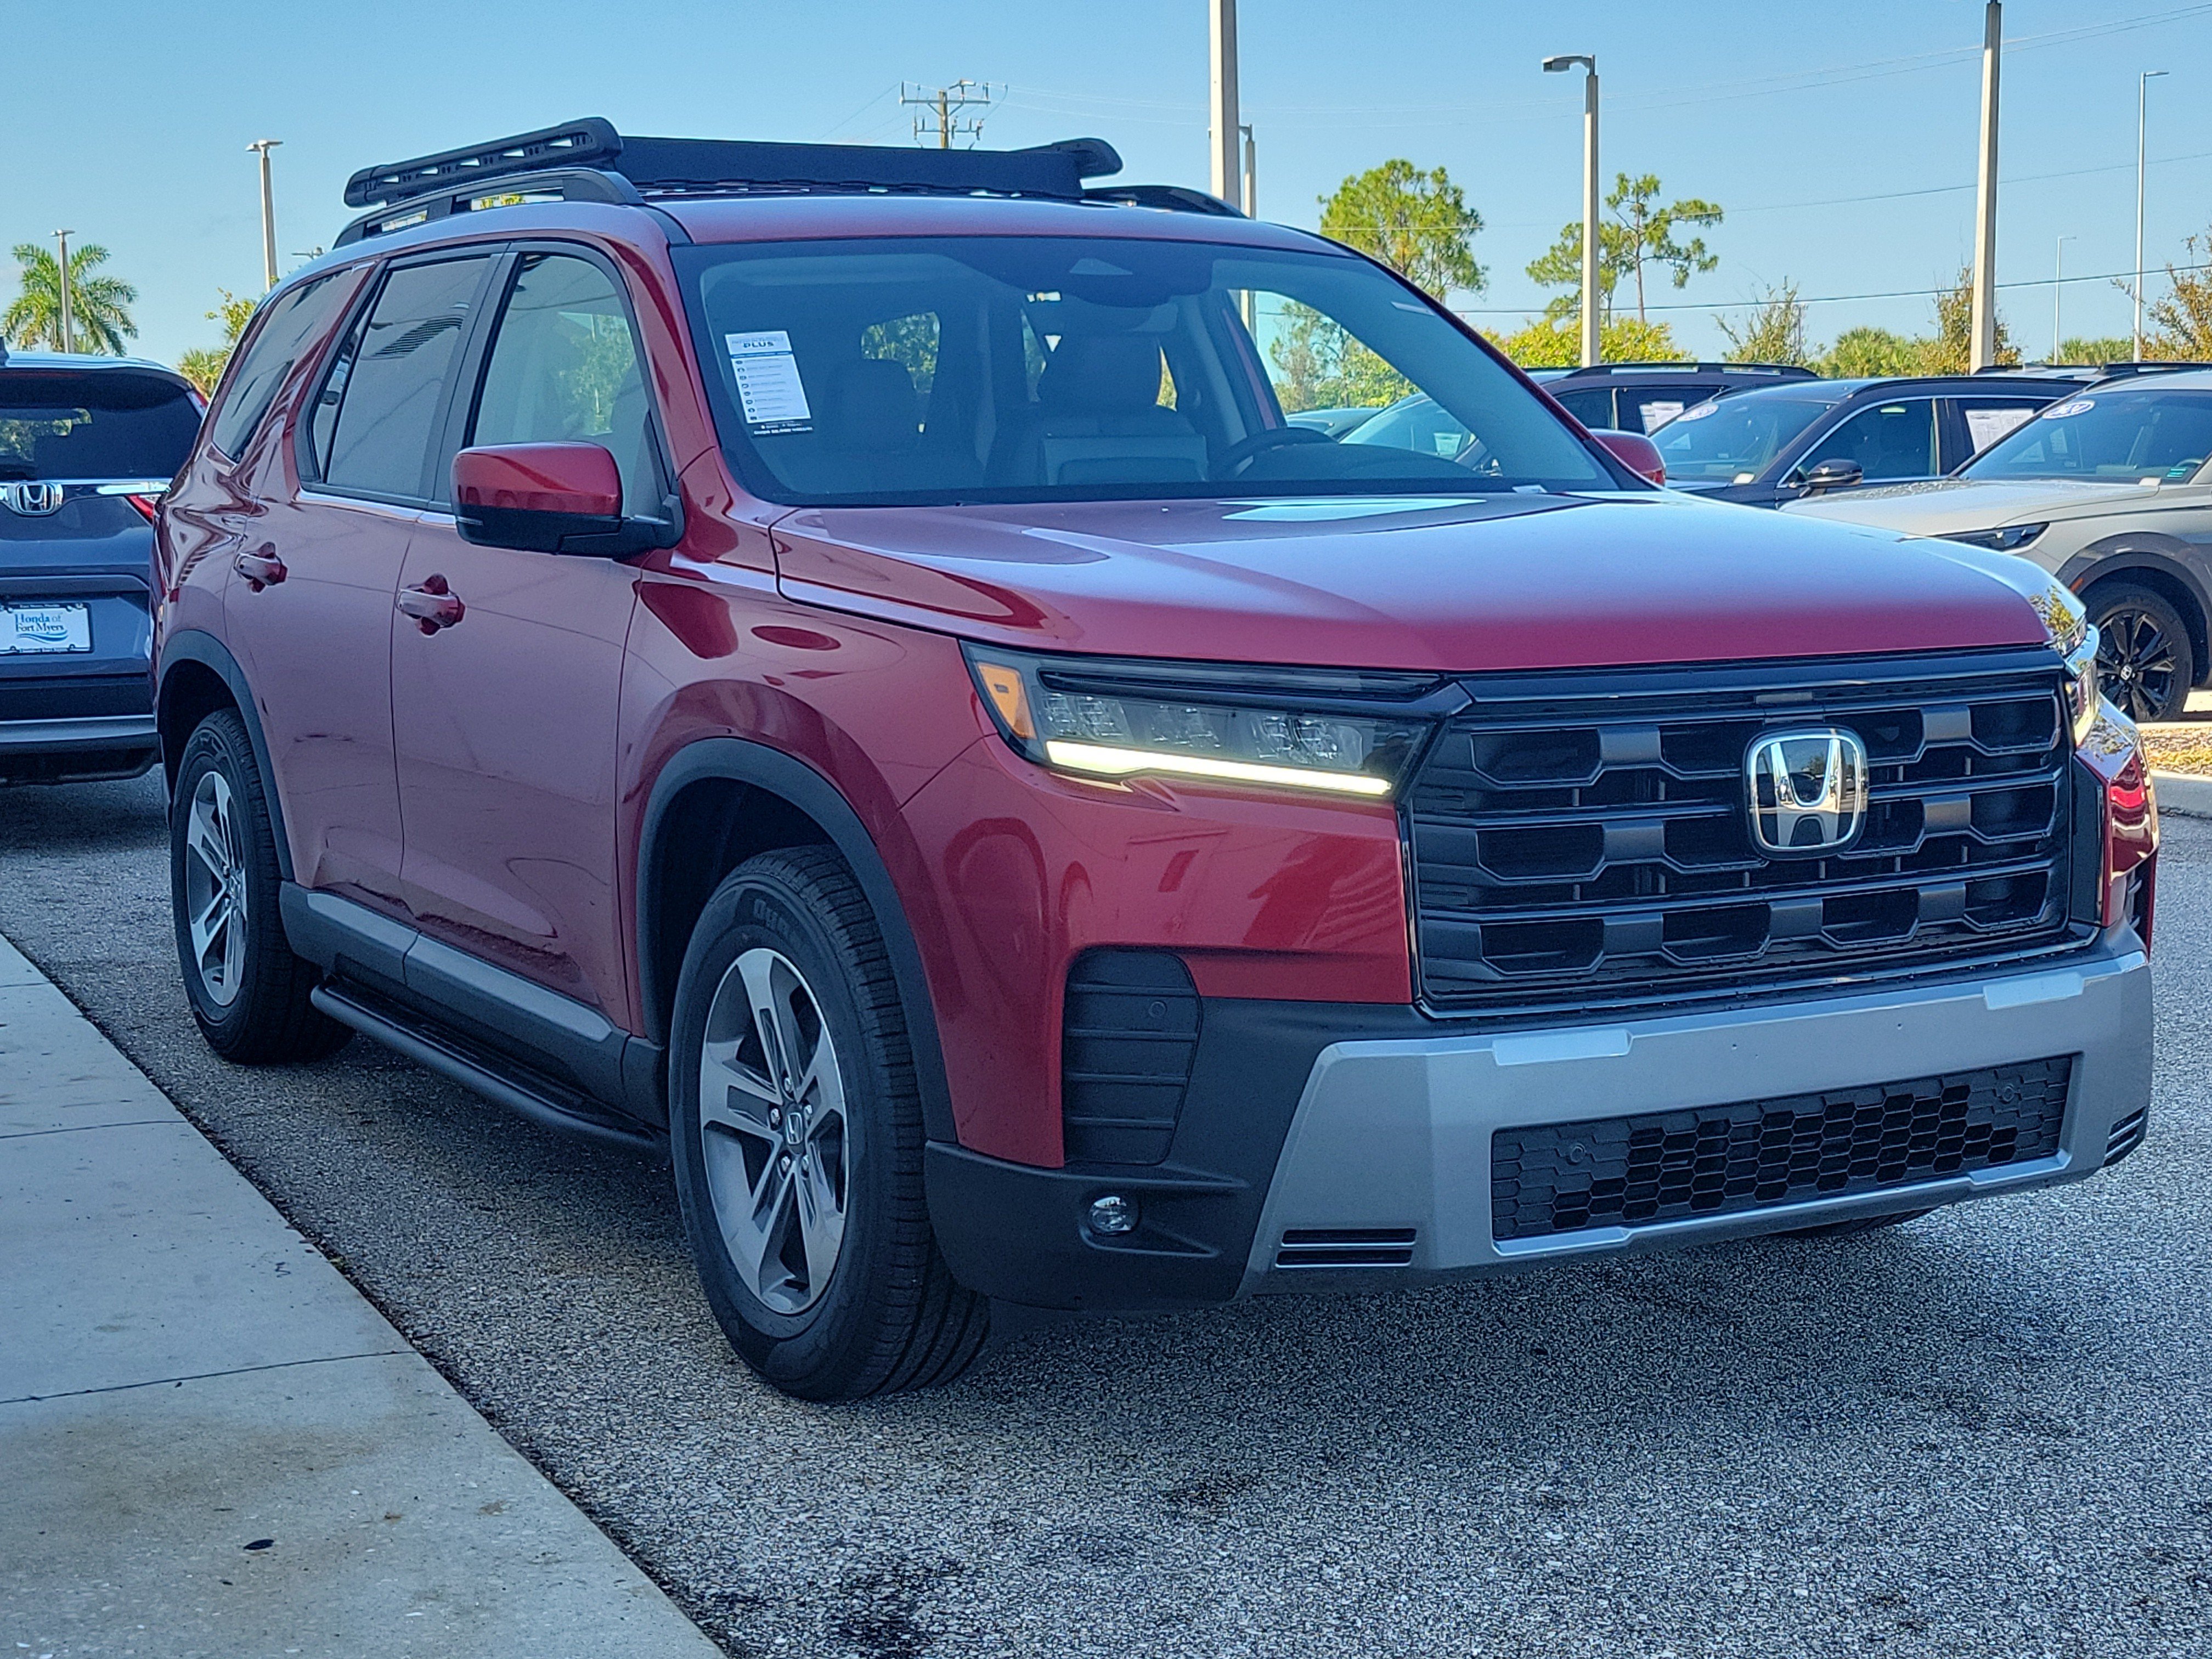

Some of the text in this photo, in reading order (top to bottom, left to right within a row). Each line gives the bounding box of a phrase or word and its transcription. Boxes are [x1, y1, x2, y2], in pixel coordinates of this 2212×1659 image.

[14, 612, 63, 623] Honda of
[15, 623, 65, 633] Fort Myers
